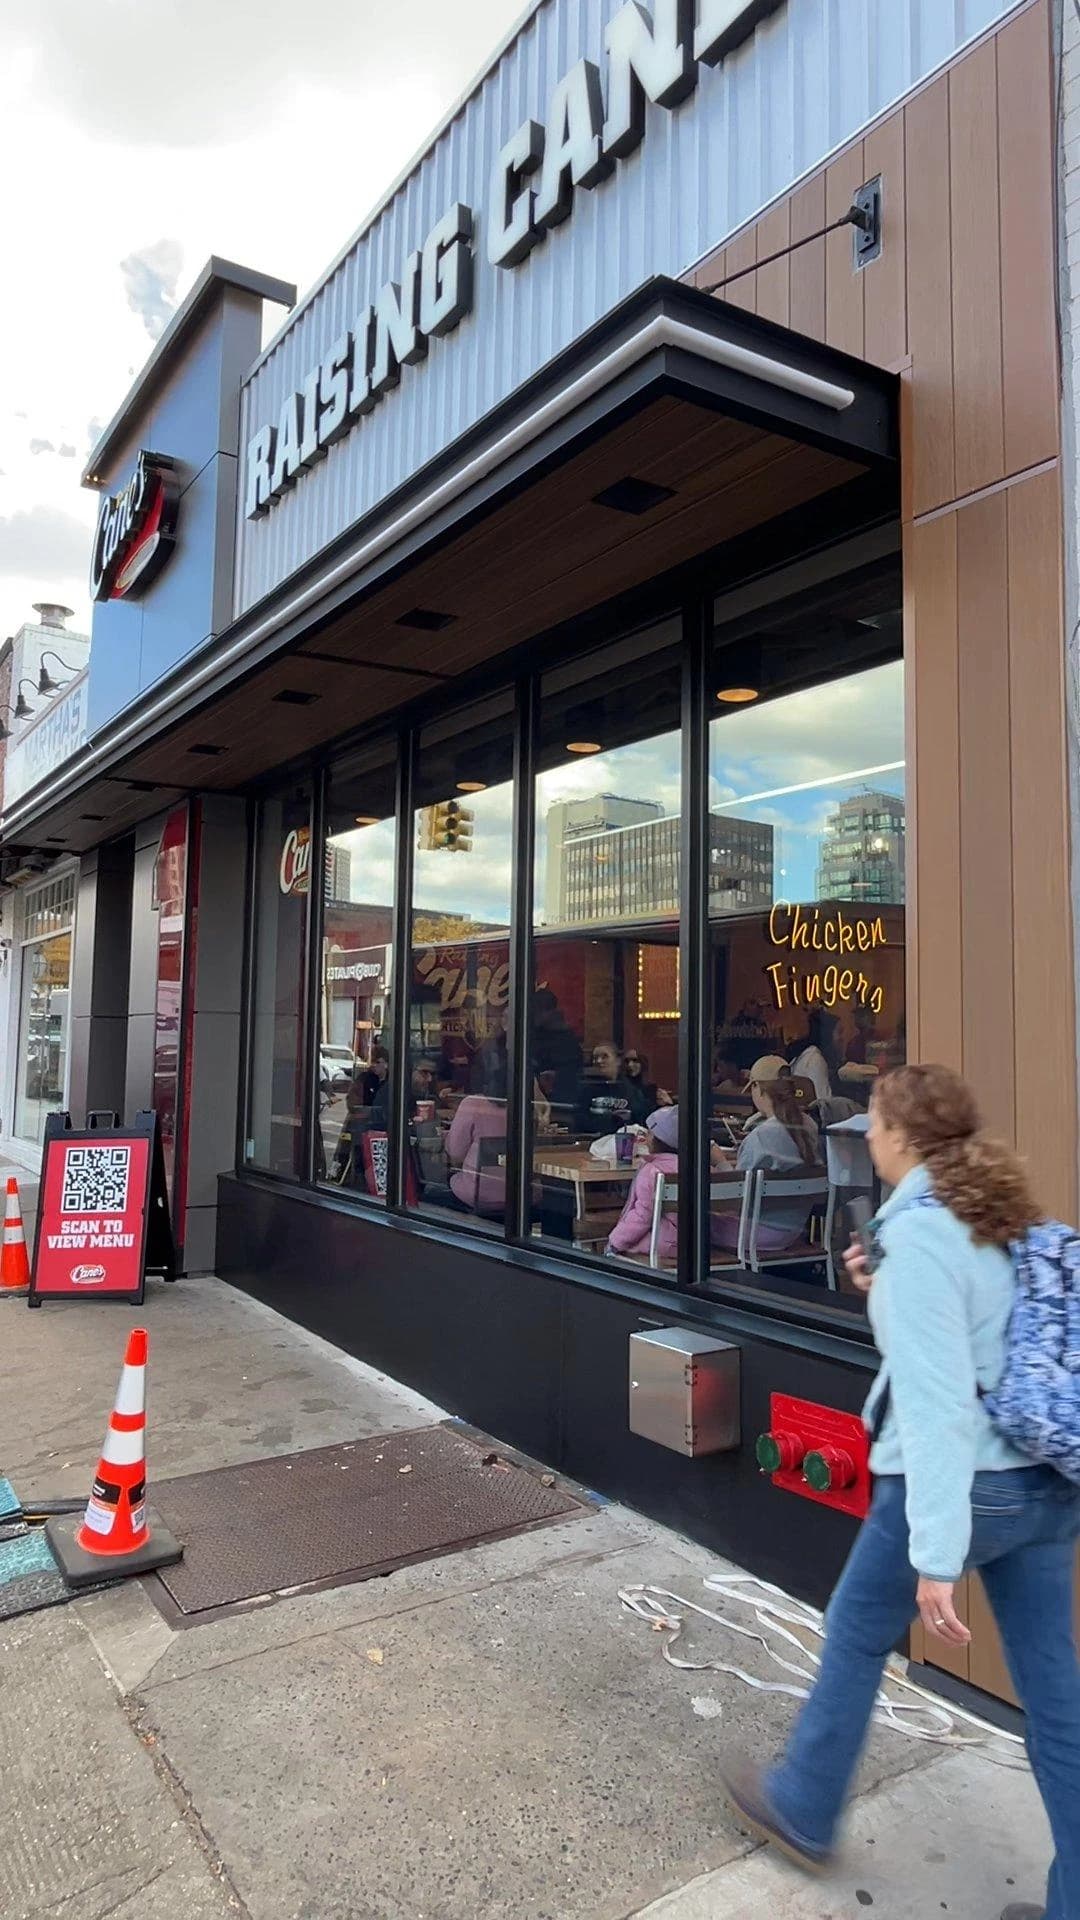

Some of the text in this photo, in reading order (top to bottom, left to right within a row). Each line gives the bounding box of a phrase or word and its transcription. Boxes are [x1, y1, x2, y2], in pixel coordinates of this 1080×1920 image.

[246, 203, 471, 520] RAISING
[769, 899, 886, 955] Chicken
[766, 961, 883, 1013] Fingers
[47, 1233, 135, 1249] VIEW MENU
[61, 1219, 123, 1234] SCAN TO
